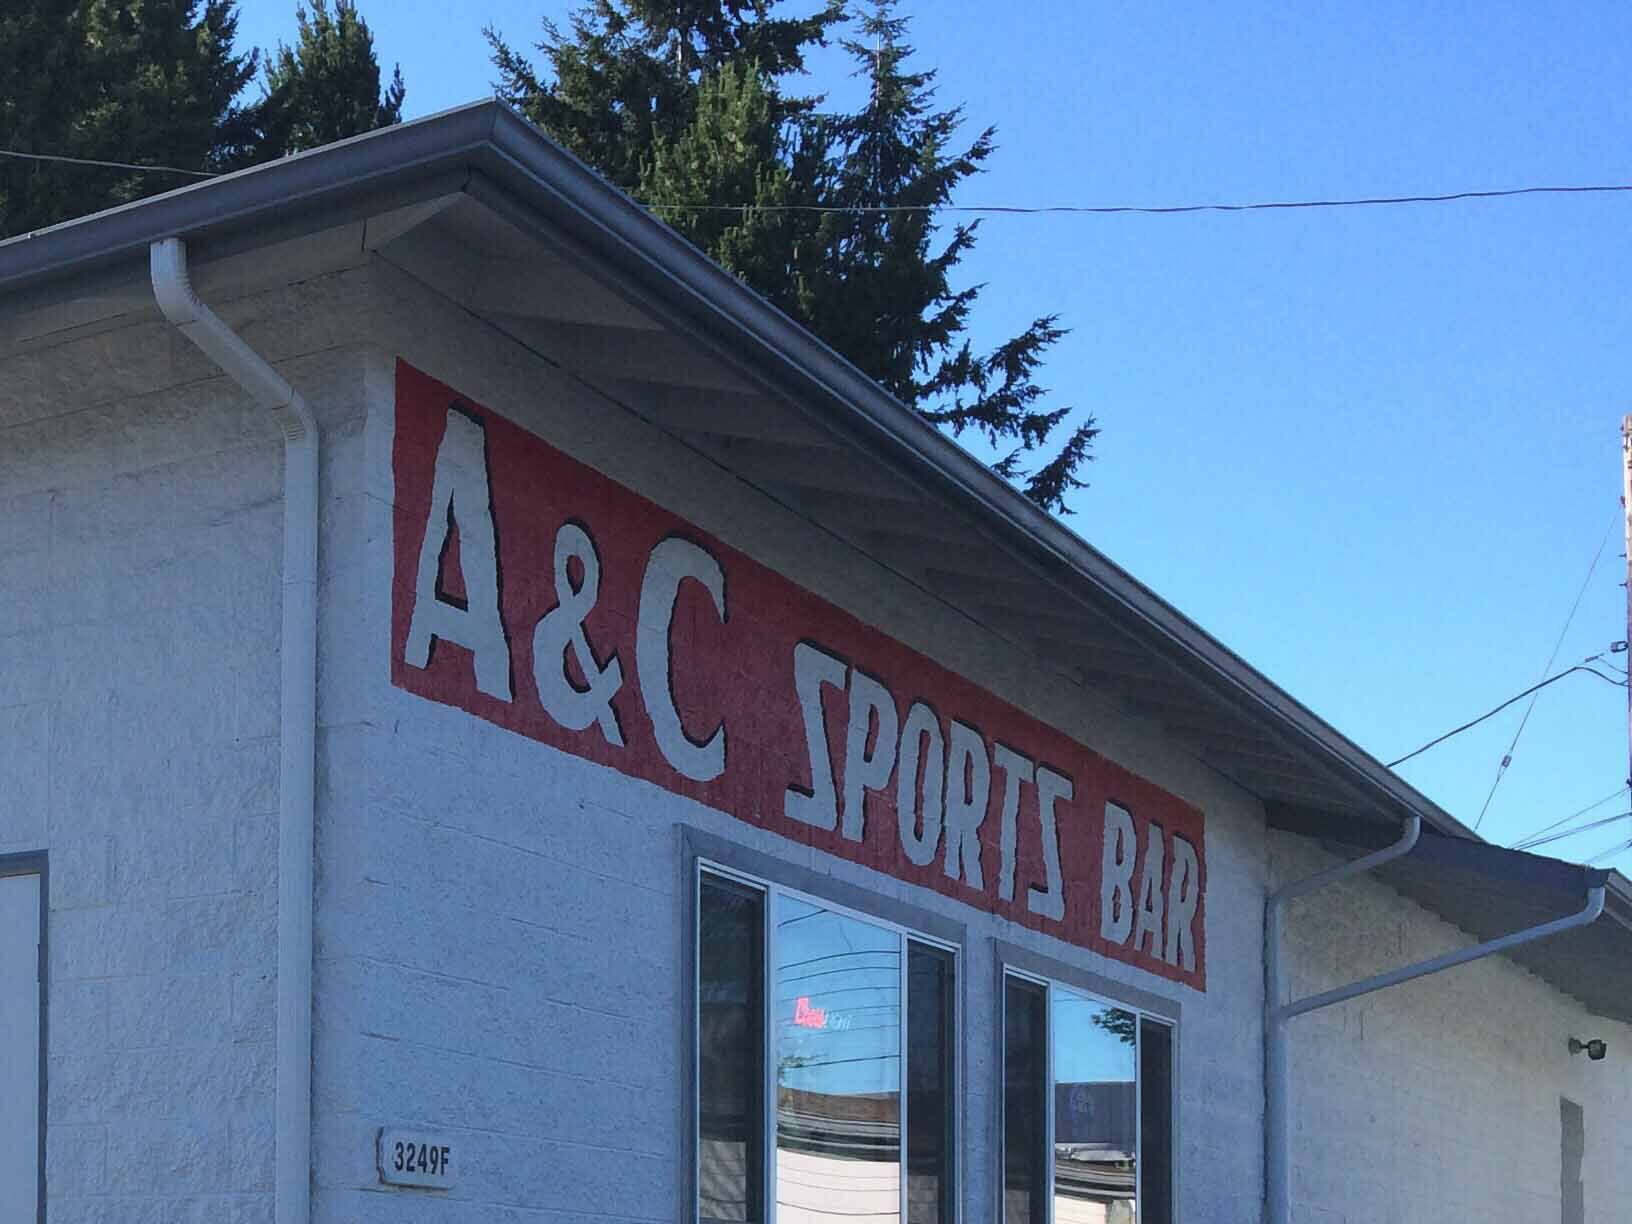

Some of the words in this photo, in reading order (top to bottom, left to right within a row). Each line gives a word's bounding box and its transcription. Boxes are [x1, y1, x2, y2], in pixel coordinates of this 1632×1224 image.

[404, 407, 728, 782] A&C
[784, 641, 1074, 922] SPORTS
[1099, 801, 1200, 974] BAR
[394, 1141, 450, 1176] 3249F
